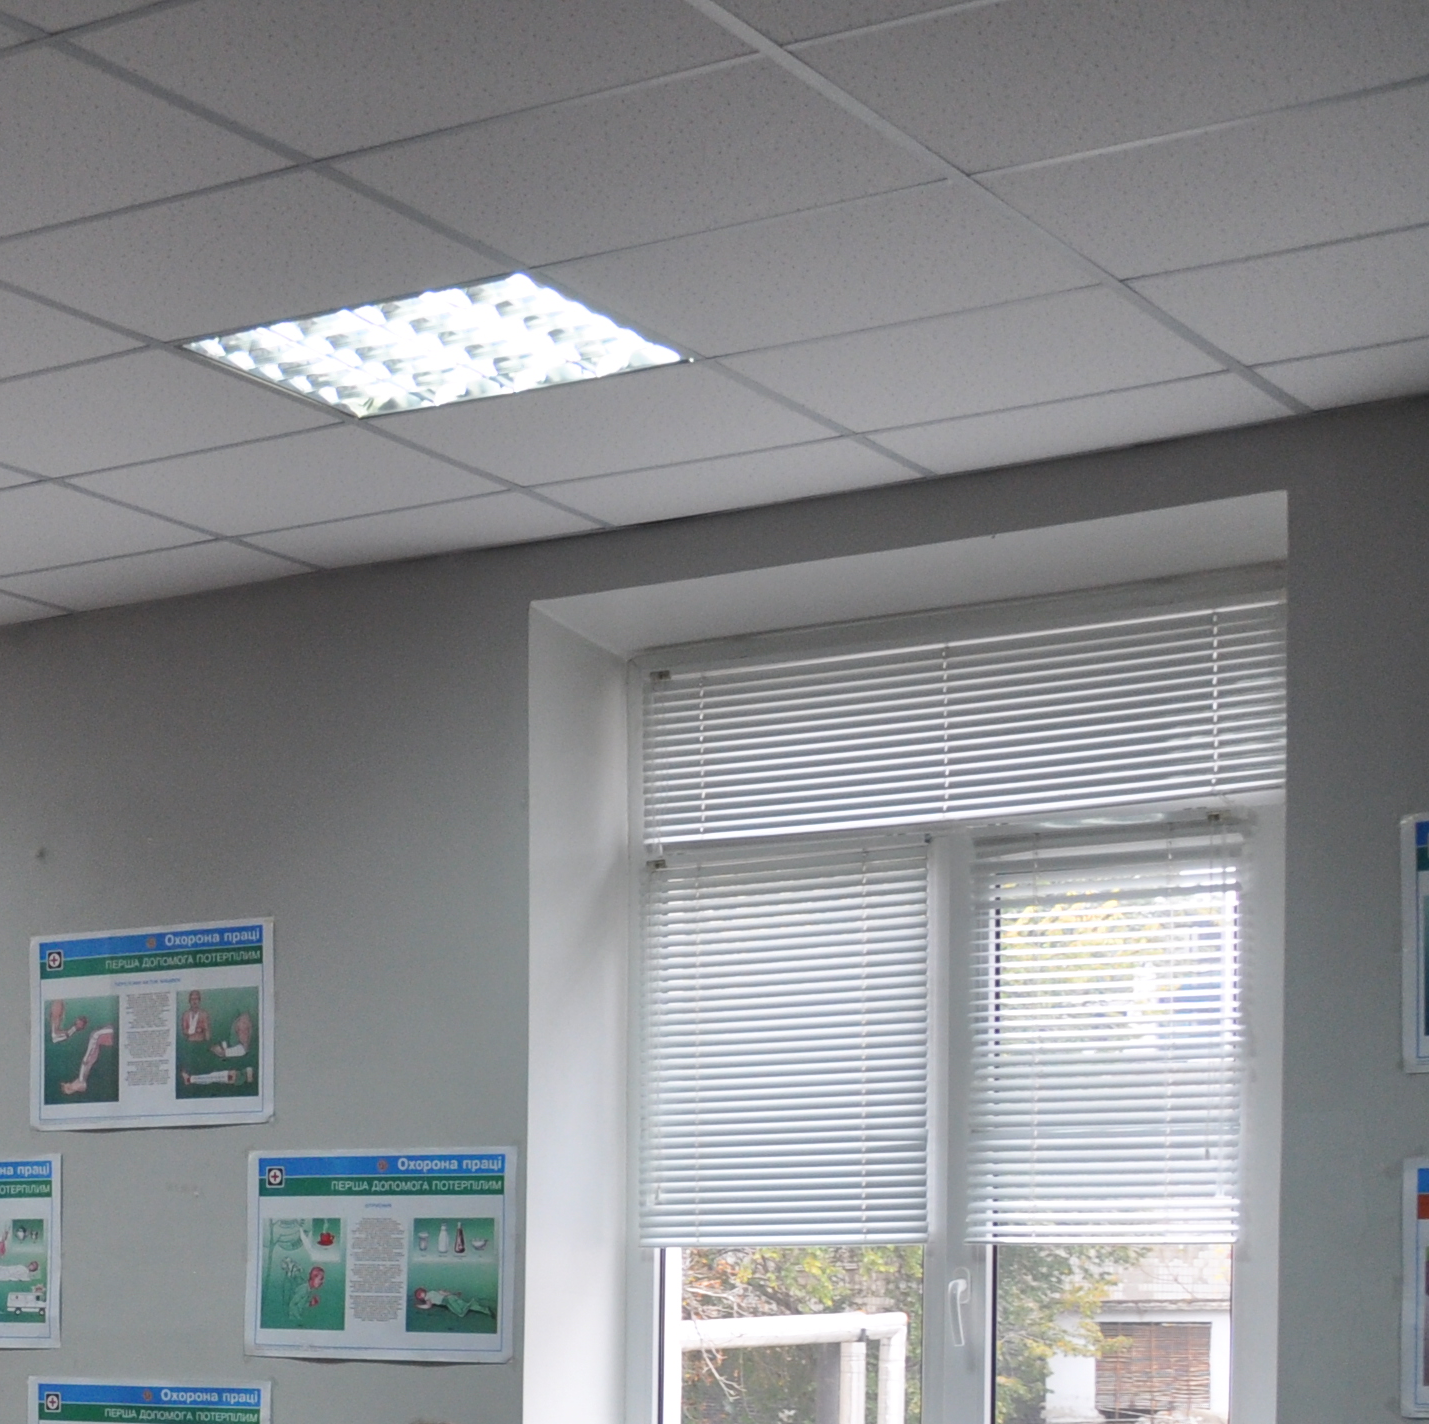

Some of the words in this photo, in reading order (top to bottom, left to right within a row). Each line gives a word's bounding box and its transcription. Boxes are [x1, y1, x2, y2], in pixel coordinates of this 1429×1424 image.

[165, 933, 220, 947] Охорона
[224, 928, 260, 944] праці
[105, 957, 140, 970] ПЕРША
[141, 954, 194, 969] ДОПОМОГА
[196, 950, 261, 964] ПОТЕРПІЛИМ
[17, 1163, 50, 1177] праці
[397, 1157, 458, 1173] Охорона
[462, 1156, 502, 1172] праці
[330, 1180, 369, 1191] ПЕРША
[371, 1180, 429, 1192] ДОПОМОГА
[432, 1180, 502, 1191] ПОТЕРПІЛИМ
[160, 1389, 219, 1403] Охорона
[222, 1390, 258, 1404] праці
[104, 1407, 137, 1419] ПЕРША
[139, 1409, 193, 1421] ДОПОМОГА
[196, 1410, 258, 1423] ПОТЕРПІЛИМ
